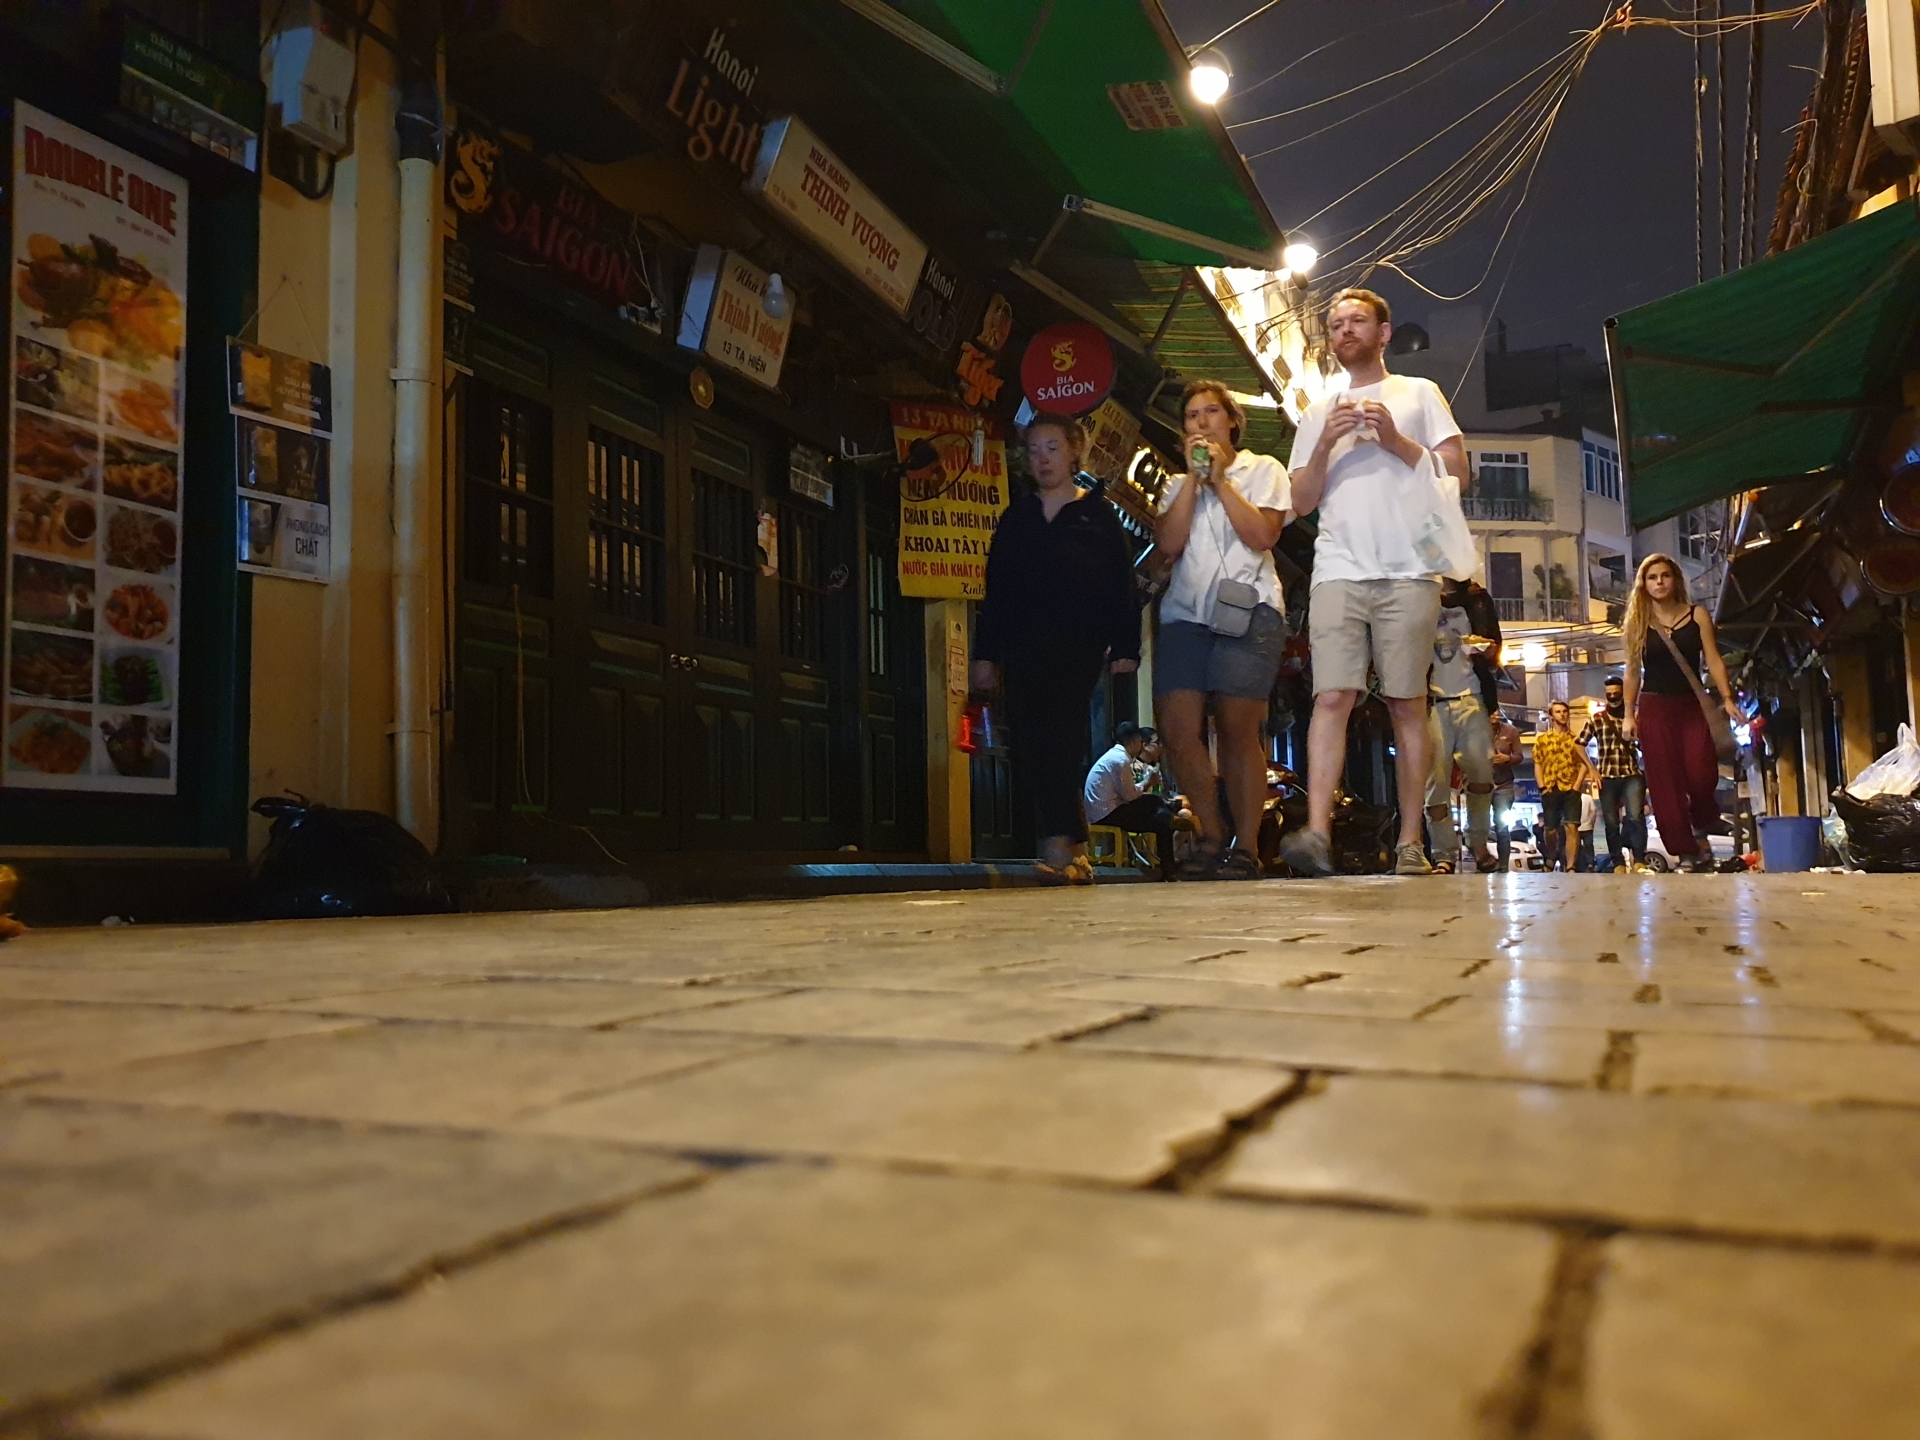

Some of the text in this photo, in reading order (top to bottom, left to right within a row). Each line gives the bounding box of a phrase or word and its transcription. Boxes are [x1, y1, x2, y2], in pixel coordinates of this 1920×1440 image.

[704, 26, 759, 97] Hanoi
[666, 57, 760, 174] Light
[25, 125, 124, 205] DOUBLE
[128, 173, 177, 238] ONE
[556, 185, 600, 232] BIA
[801, 163, 900, 273] THỊNH VƯỢNG
[924, 257, 957, 301] Hanoi
[722, 340, 768, 374] 13 TẠ HIỆN
[1036, 380, 1095, 401] SAIGON
[1056, 374, 1075, 386] BIA
[901, 406, 921, 425] 13
[931, 502, 948, 527] GÀ
[904, 535, 950, 554] KHOAI
[952, 534, 980, 556] TÂY
